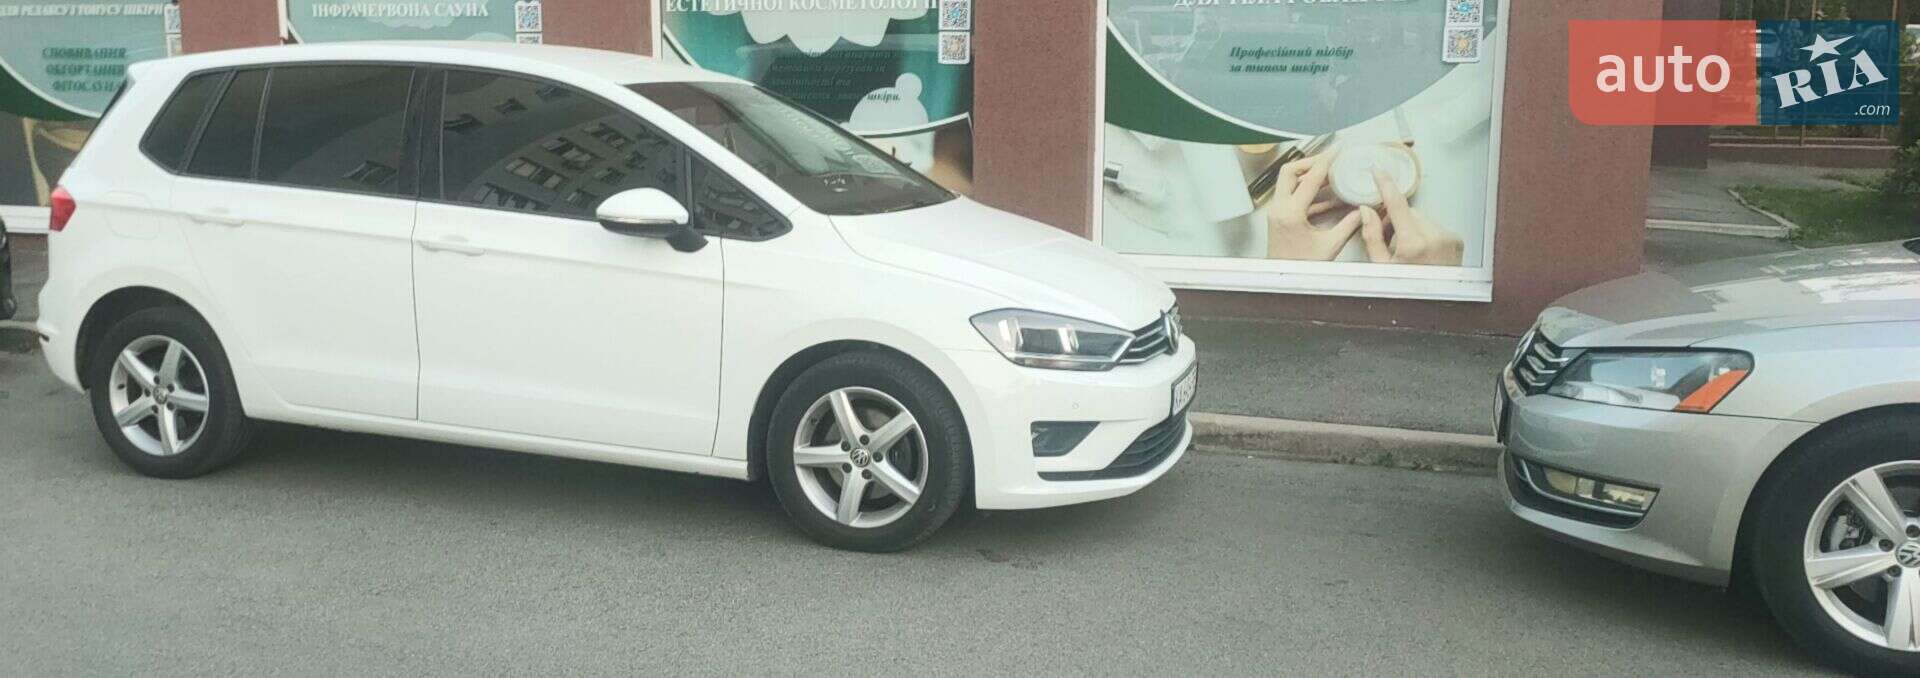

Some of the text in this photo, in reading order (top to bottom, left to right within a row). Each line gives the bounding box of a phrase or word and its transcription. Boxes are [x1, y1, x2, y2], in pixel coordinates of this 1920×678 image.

[312, 0, 489, 18] ІНФРАЧЕРВОНА САУНА
[1229, 45, 1354, 60] Професійний підбір
[1229, 61, 1330, 75] за типом шкіри
